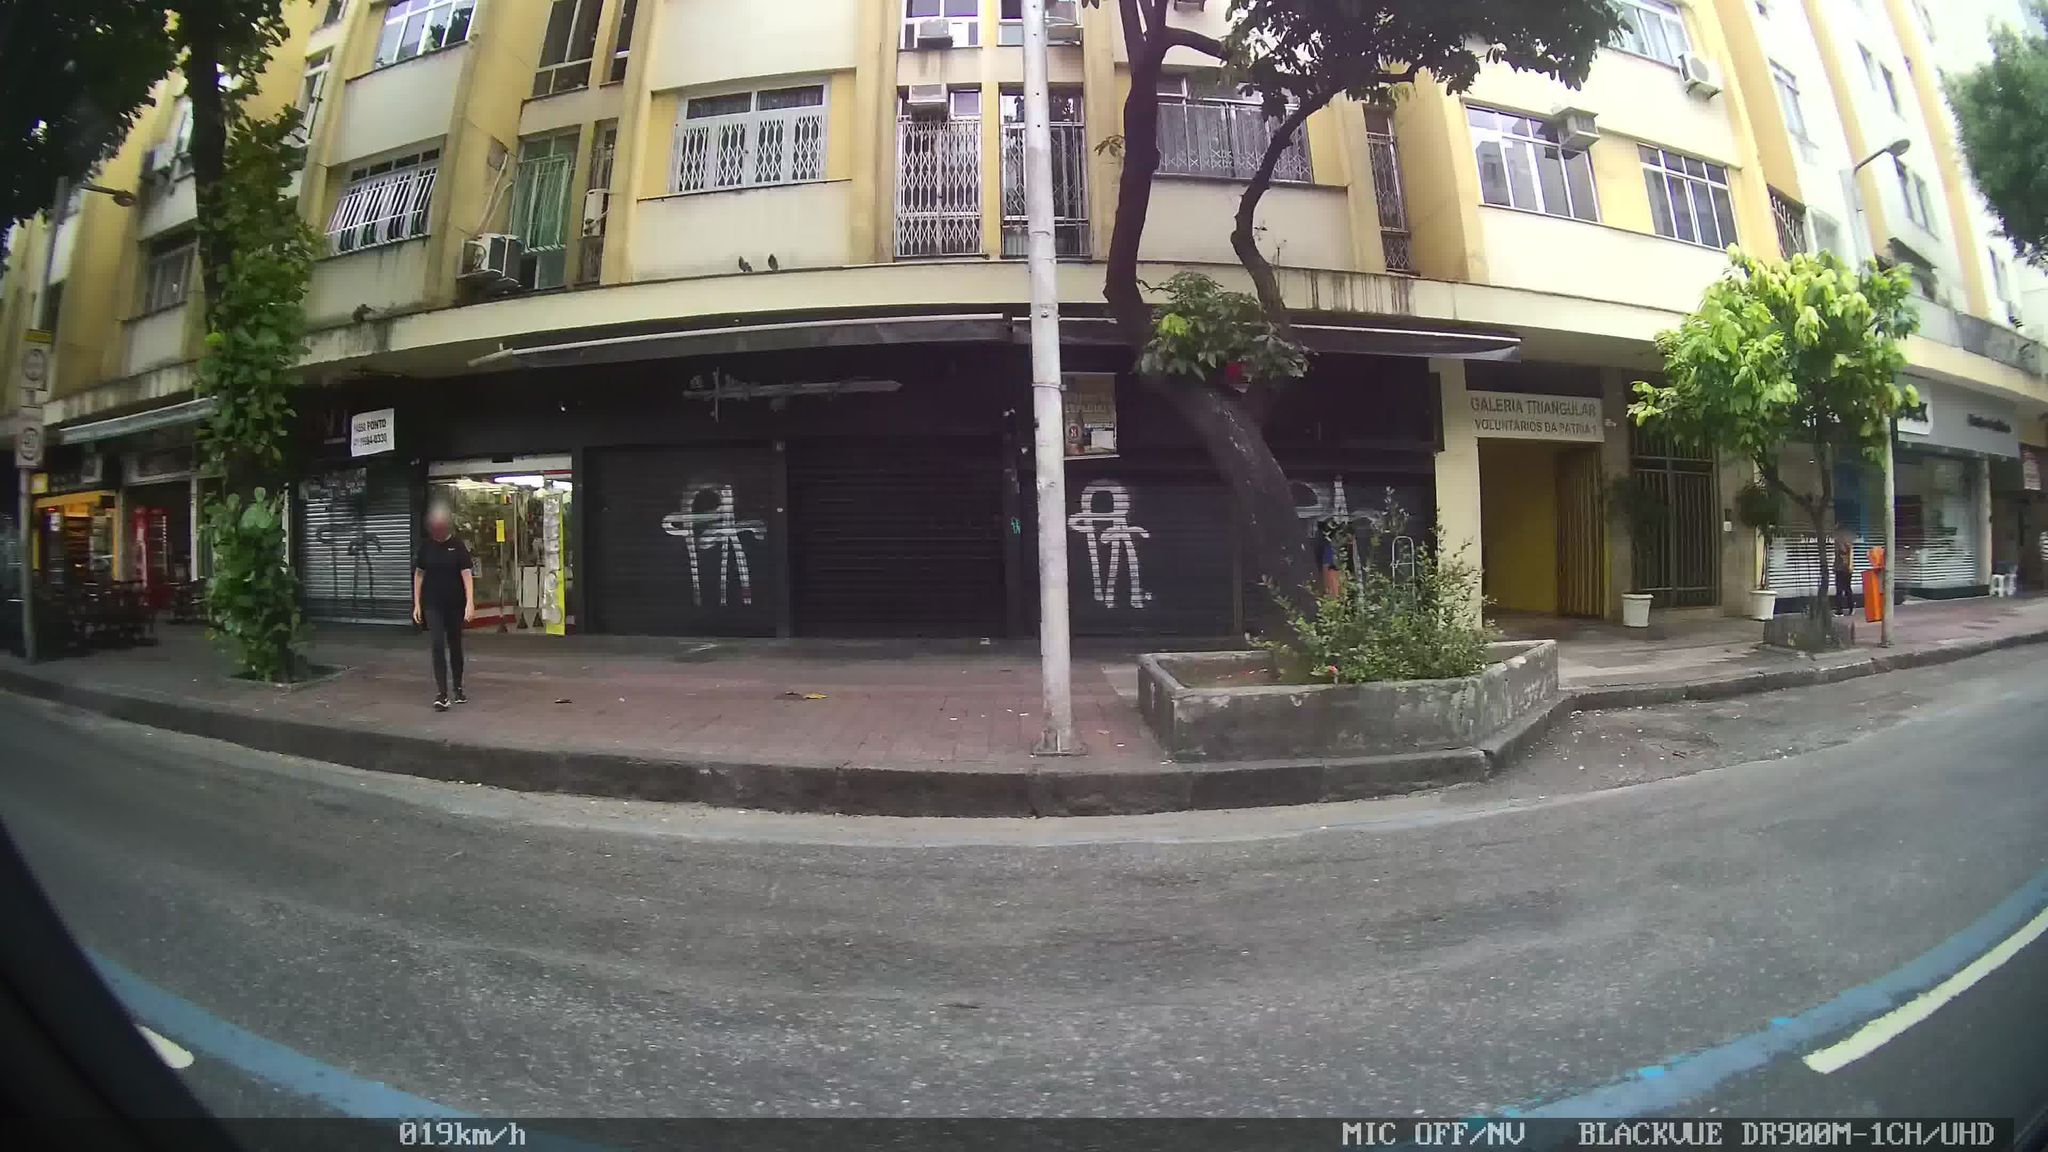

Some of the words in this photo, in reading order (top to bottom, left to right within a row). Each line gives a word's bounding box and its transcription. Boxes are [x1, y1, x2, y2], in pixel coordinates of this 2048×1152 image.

[1471, 397, 1523, 414] GALERIA
[1527, 400, 1596, 417] TRIANGULAR
[366, 418, 387, 430] PONTO
[1544, 422, 1558, 433] DA
